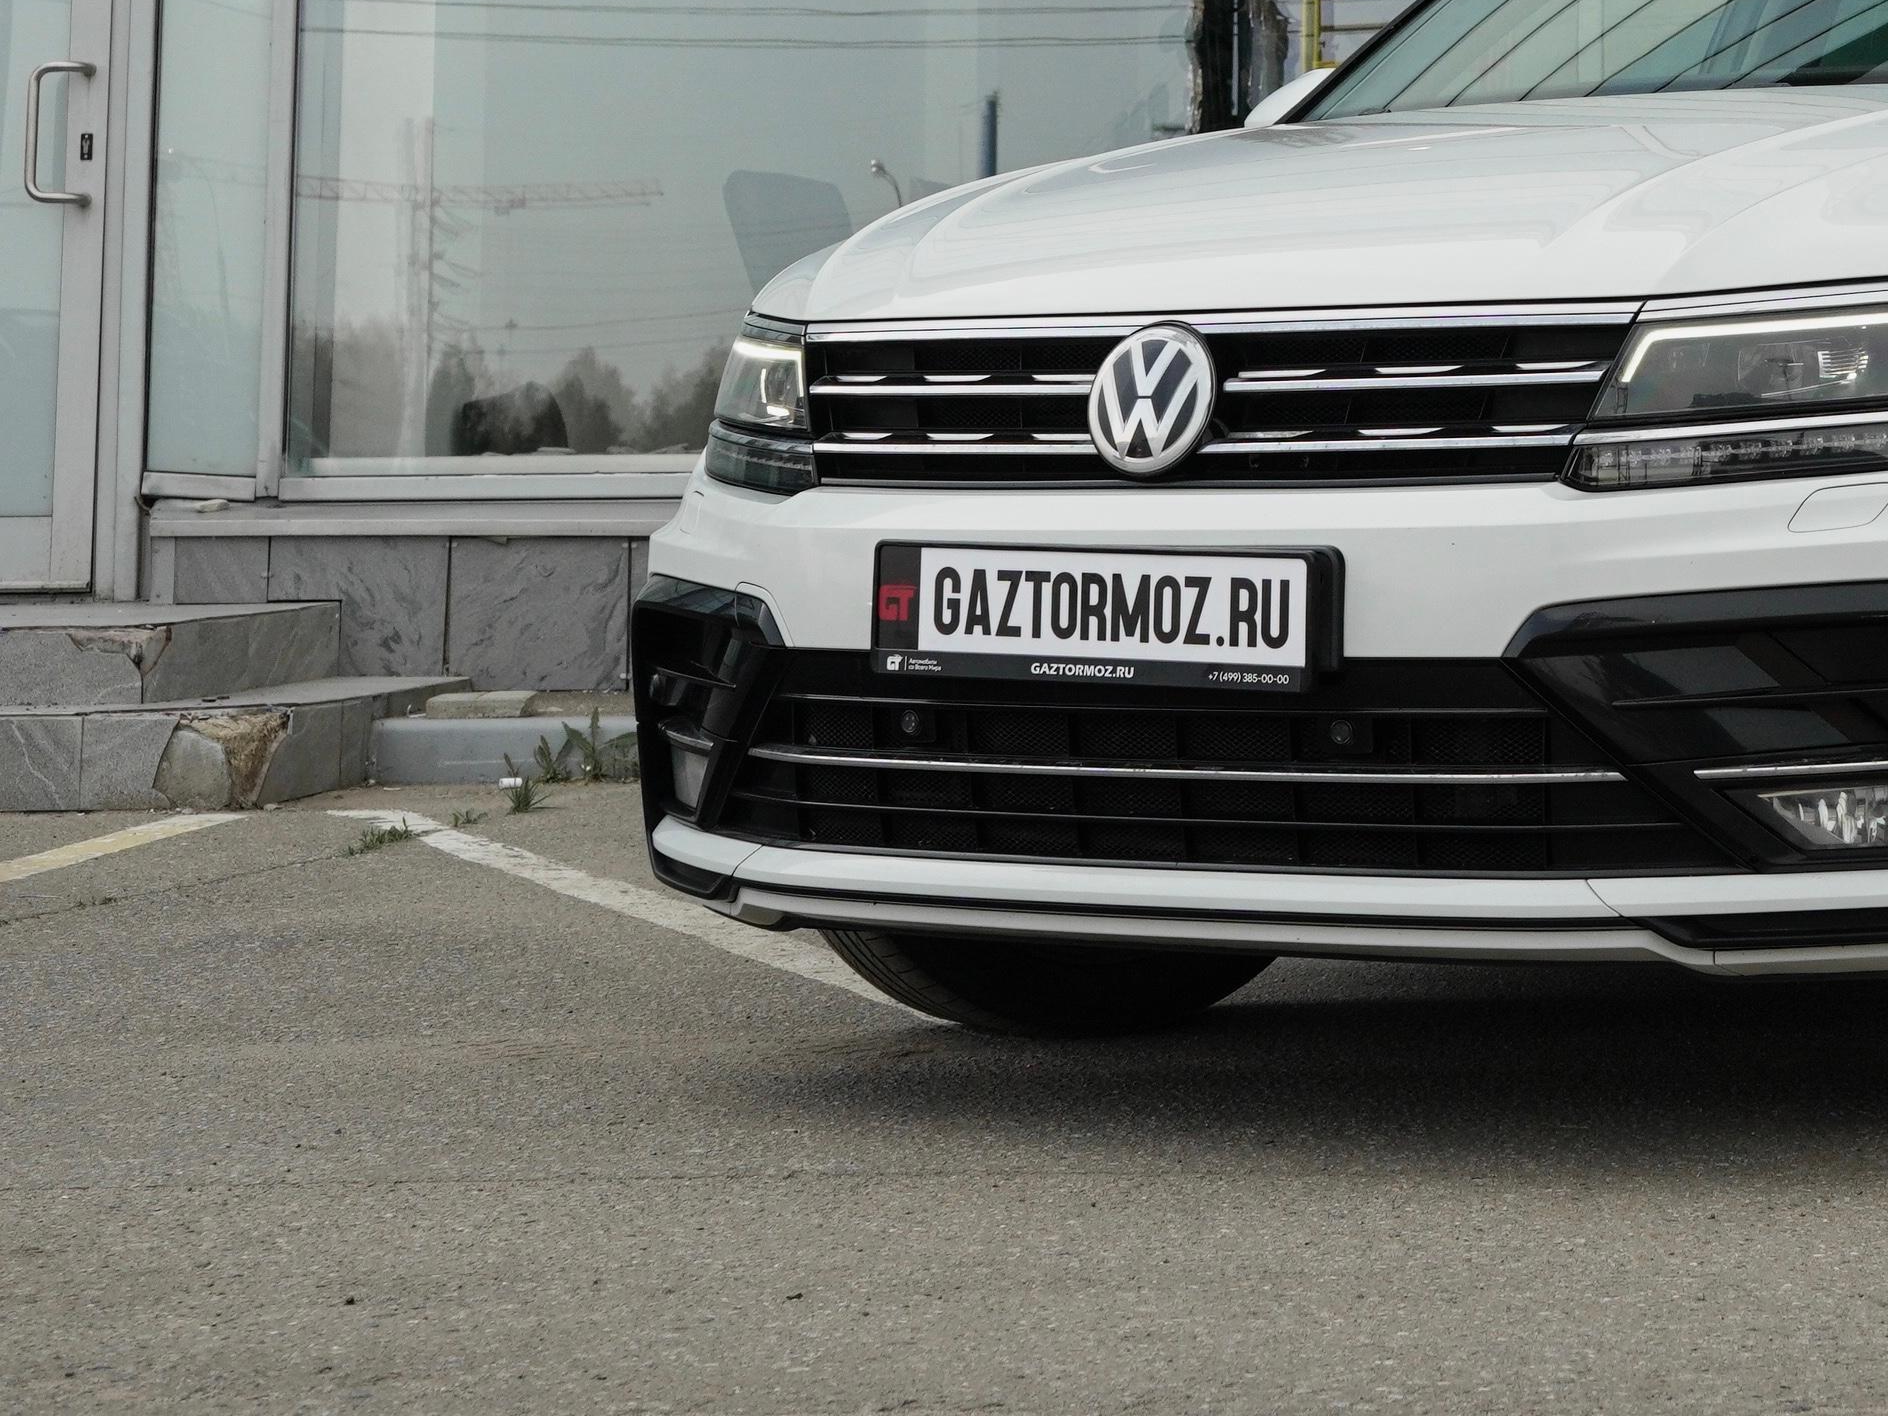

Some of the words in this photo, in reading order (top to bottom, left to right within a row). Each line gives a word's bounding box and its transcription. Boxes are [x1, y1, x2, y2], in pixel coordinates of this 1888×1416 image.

[933, 566, 1290, 650] GAZTORMOZ.RU
[1030, 662, 1135, 679] GAZTORMOZ.RU
[1208, 671, 1219, 681] +7
[1219, 671, 1242, 683] (499)
[1242, 672, 1290, 685] 385-00-00
